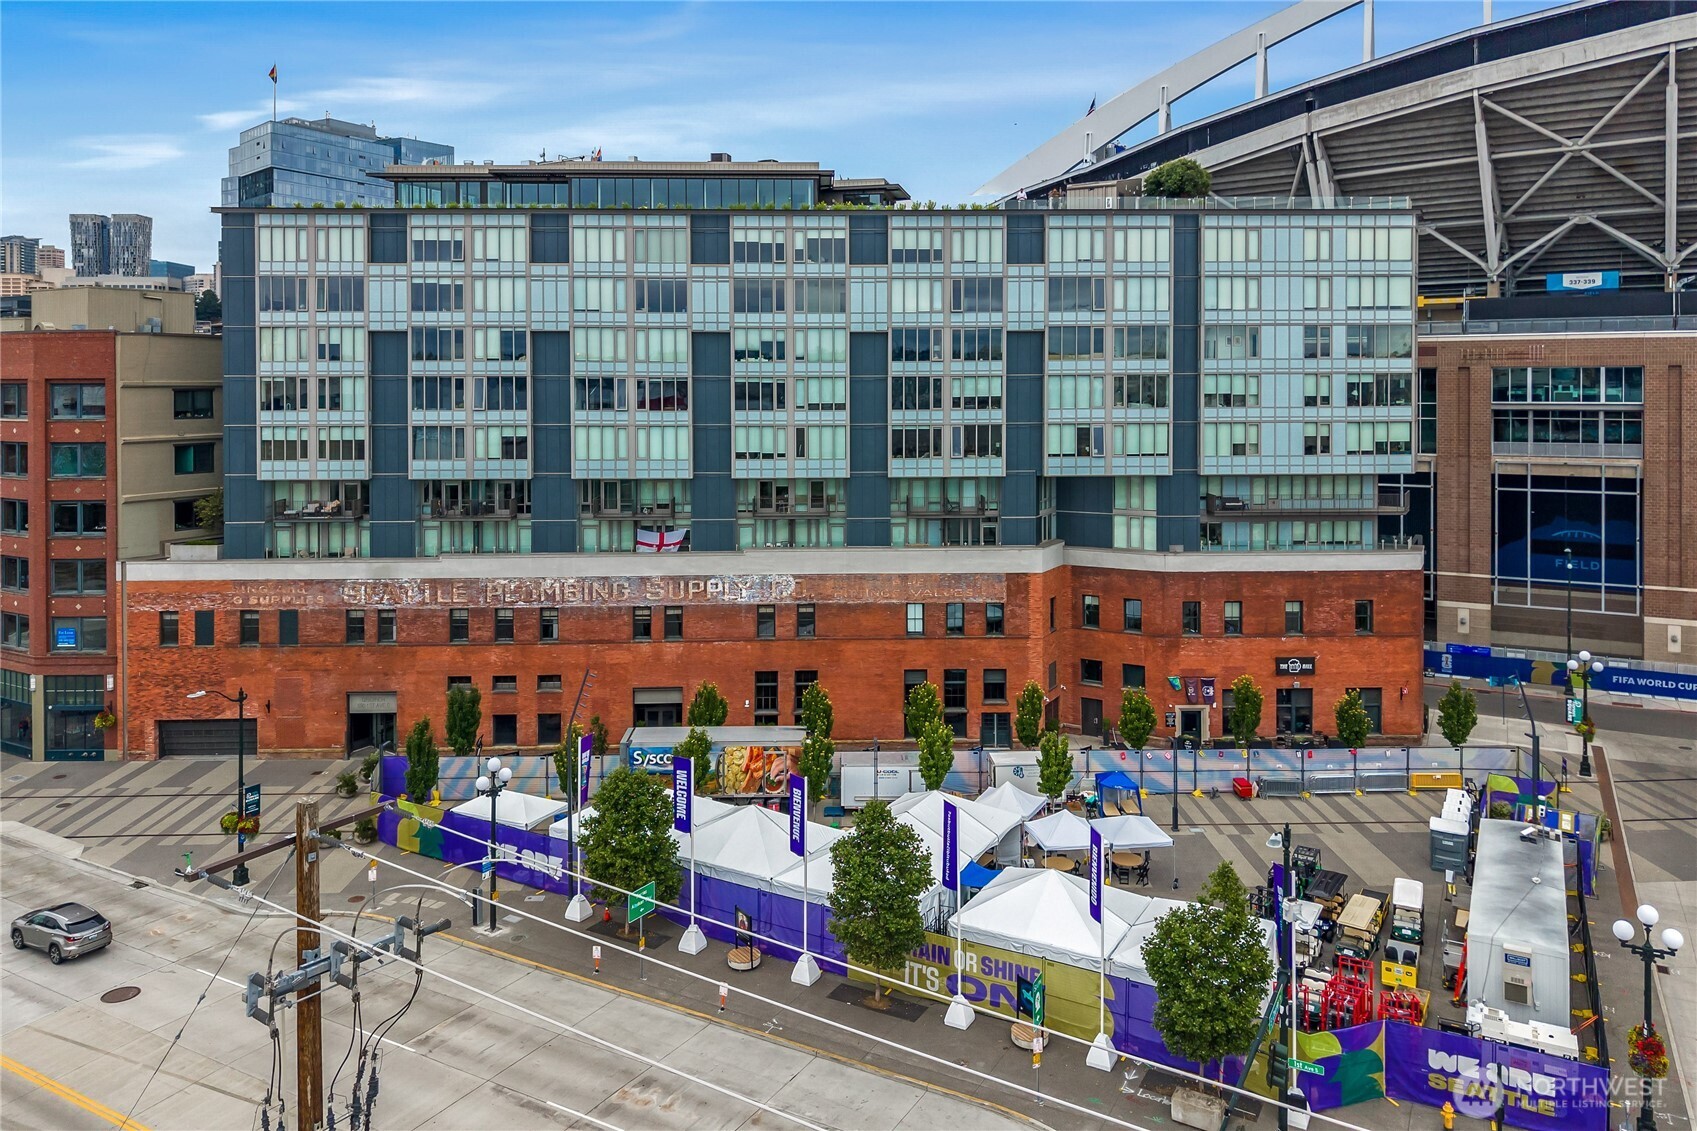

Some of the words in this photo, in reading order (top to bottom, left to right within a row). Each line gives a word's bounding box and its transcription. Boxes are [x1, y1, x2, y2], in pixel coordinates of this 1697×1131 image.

[1568, 278, 1596, 286] 337-339
[1555, 559, 1600, 570] FIELD
[485, 578, 631, 604] PLUMBING
[646, 577, 752, 601] SUPPLY
[1612, 675, 1635, 685] FIFA
[1636, 678, 1676, 689] WORLD
[676, 770, 687, 820] WELCOME
[793, 788, 801, 843] BIENVENUE
[912, 943, 951, 967] AIN
[953, 949, 978, 973] OR
[904, 960, 940, 992] IT'S
[1293, 1060, 1303, 1069] 1st
[1428, 1048, 1480, 1079] WE
[1427, 1073, 1556, 1117] SEATTLE
